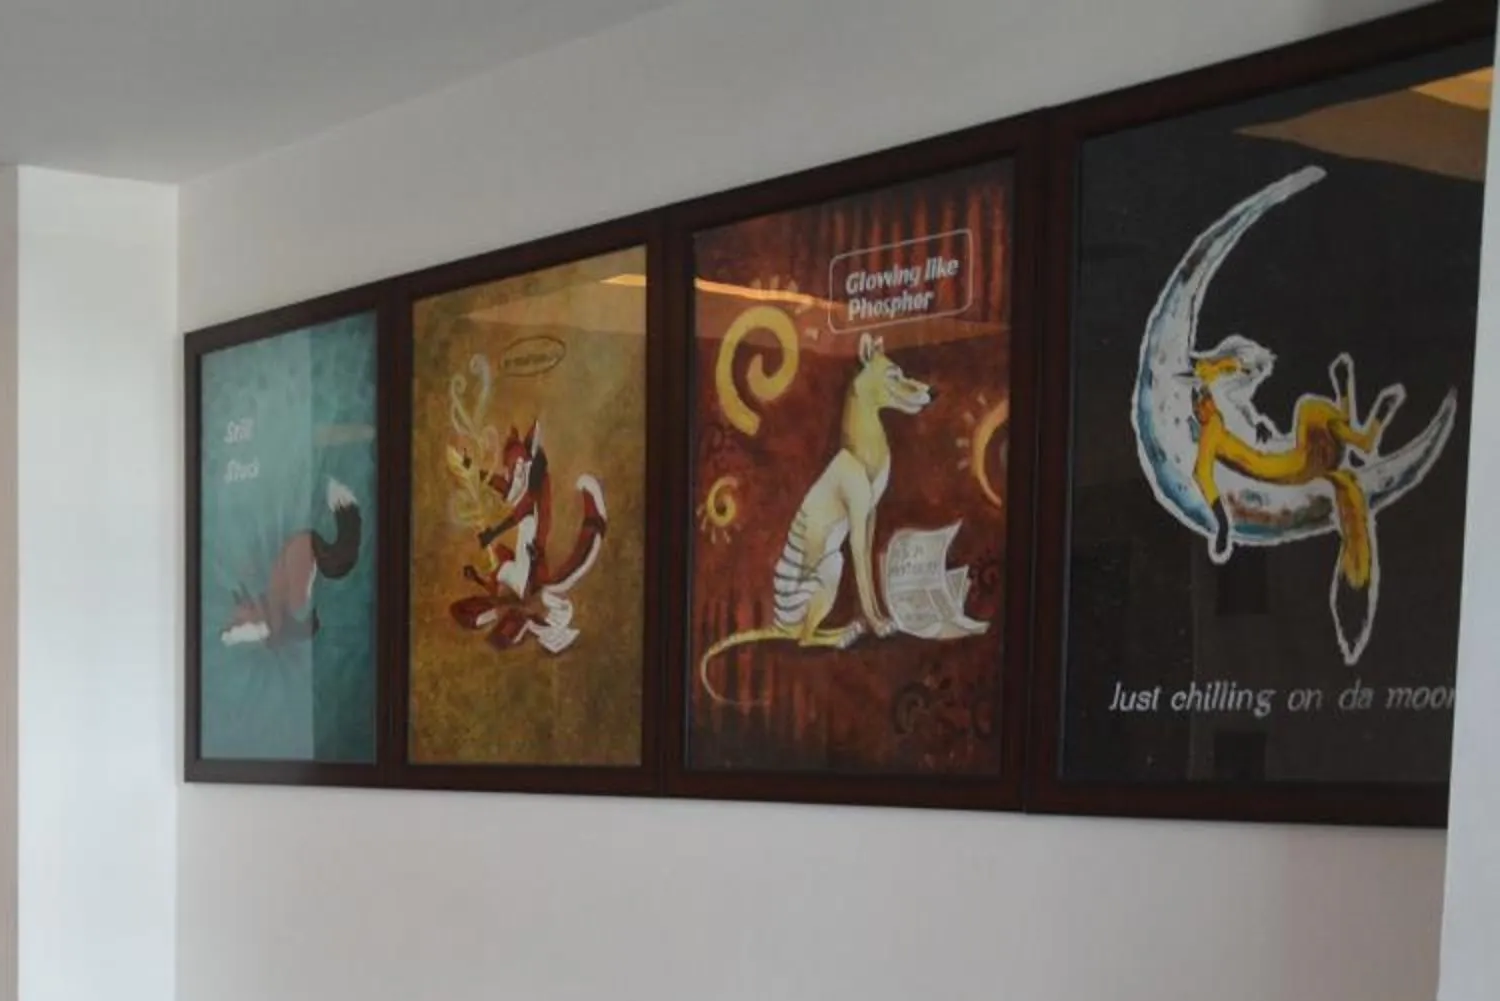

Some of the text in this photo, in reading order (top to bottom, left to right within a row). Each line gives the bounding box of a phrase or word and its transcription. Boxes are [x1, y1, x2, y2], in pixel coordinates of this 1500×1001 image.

[845, 256, 959, 294] Glowing like
[848, 291, 934, 321] Phosphor
[1109, 682, 1161, 711] Just
[1171, 681, 1276, 717] chilling
[1287, 687, 1322, 711] on
[1338, 679, 1374, 710] da
